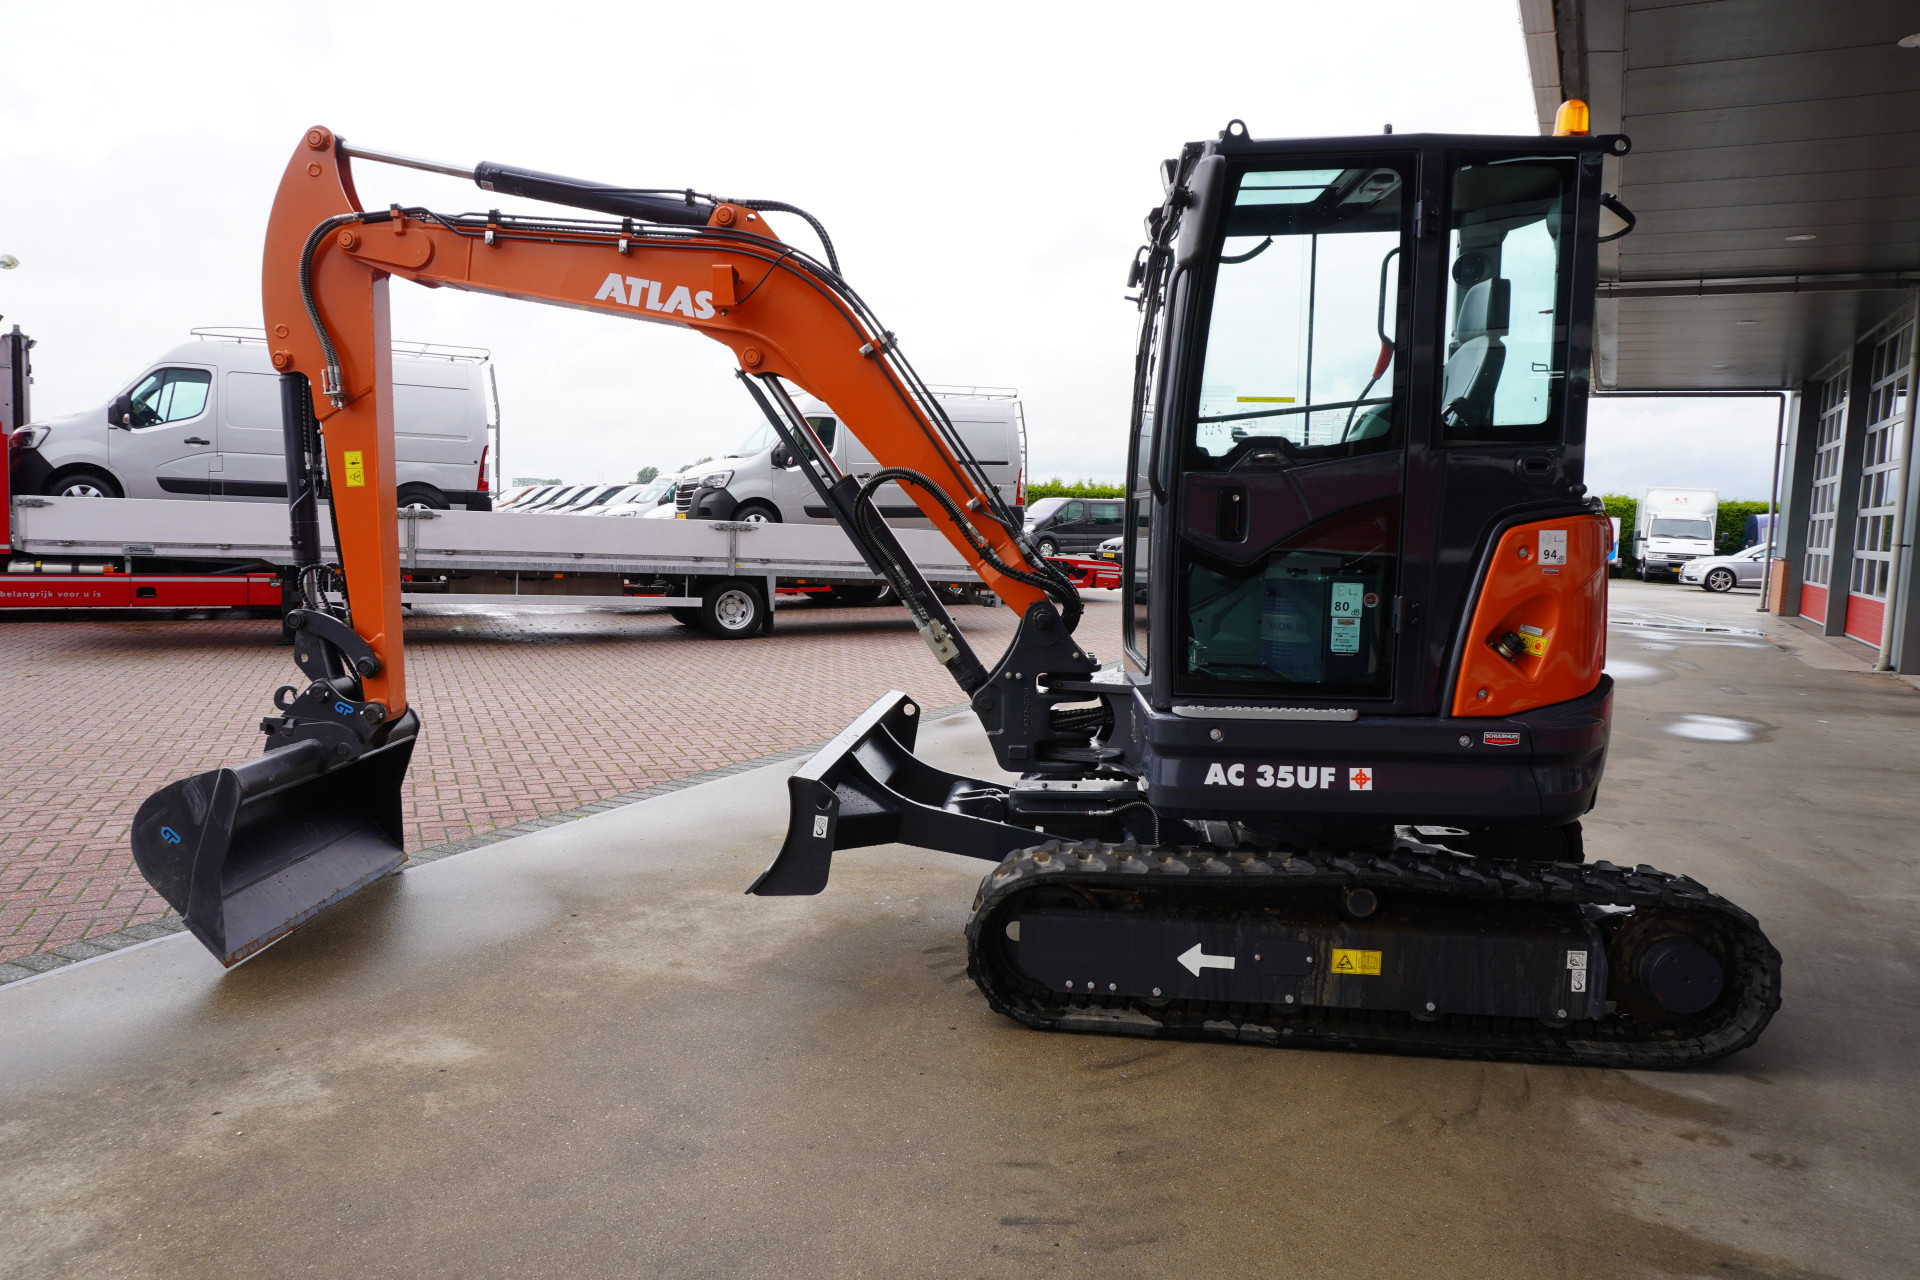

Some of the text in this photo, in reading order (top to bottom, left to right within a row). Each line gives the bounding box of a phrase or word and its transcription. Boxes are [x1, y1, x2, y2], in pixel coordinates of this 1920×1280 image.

[594, 272, 716, 320] ATLAS
[1543, 549, 1557, 560] 94
[1556, 556, 1565, 564] dB
[1334, 601, 1350, 611] 80
[1351, 608, 1360, 616] dB
[1204, 763, 1336, 789] AC 35UF
